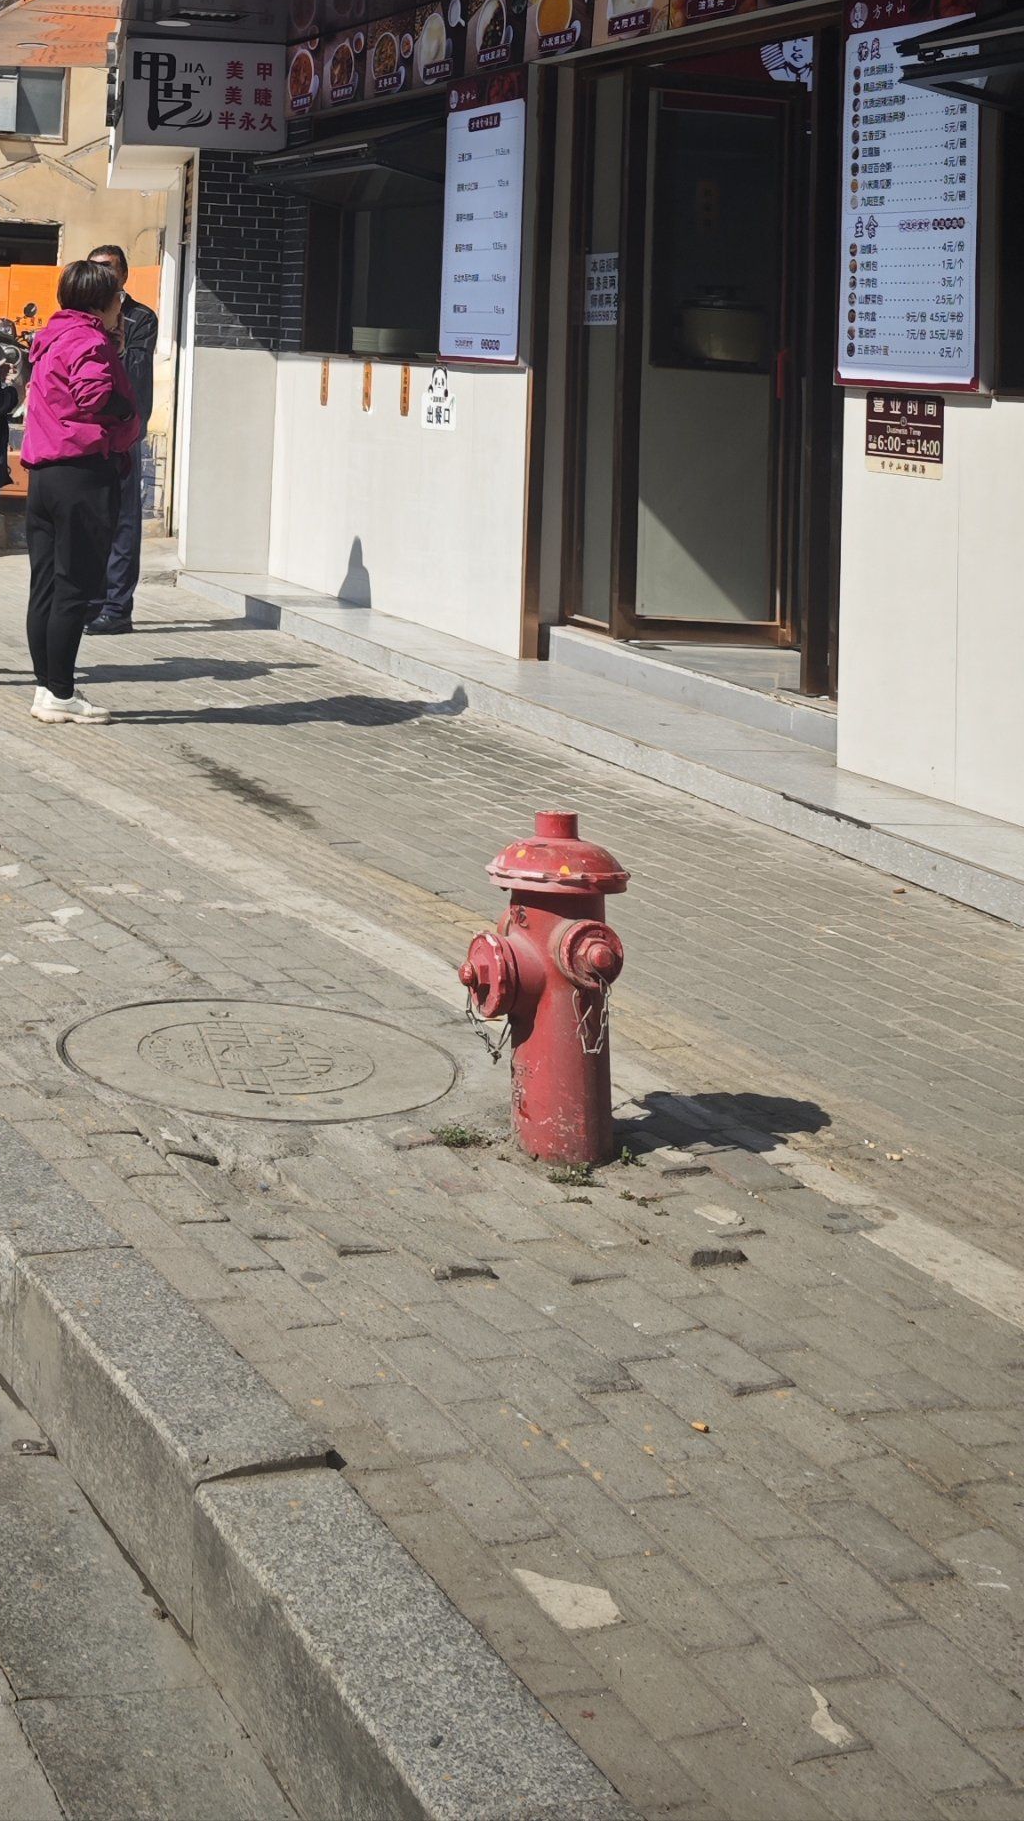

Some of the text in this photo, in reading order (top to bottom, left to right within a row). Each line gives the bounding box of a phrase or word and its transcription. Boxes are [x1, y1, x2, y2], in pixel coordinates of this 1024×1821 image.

[872, 0, 907, 21] 方中山
[179, 62, 206, 74] JIA
[226, 60, 274, 81] 美甲
[198, 75, 213, 87] YI
[224, 85, 274, 107] 美睫
[217, 111, 278, 132] 半永久
[941, 240, 965, 253] 4元/份
[942, 258, 965, 271] 1元/个
[859, 275, 964, 289] 牛肉包 3元/个
[426, 405, 451, 425] 出餐口
[873, 397, 937, 417] 营业时间
[909, 426, 922, 437] Time
[916, 439, 941, 456] 14:00
